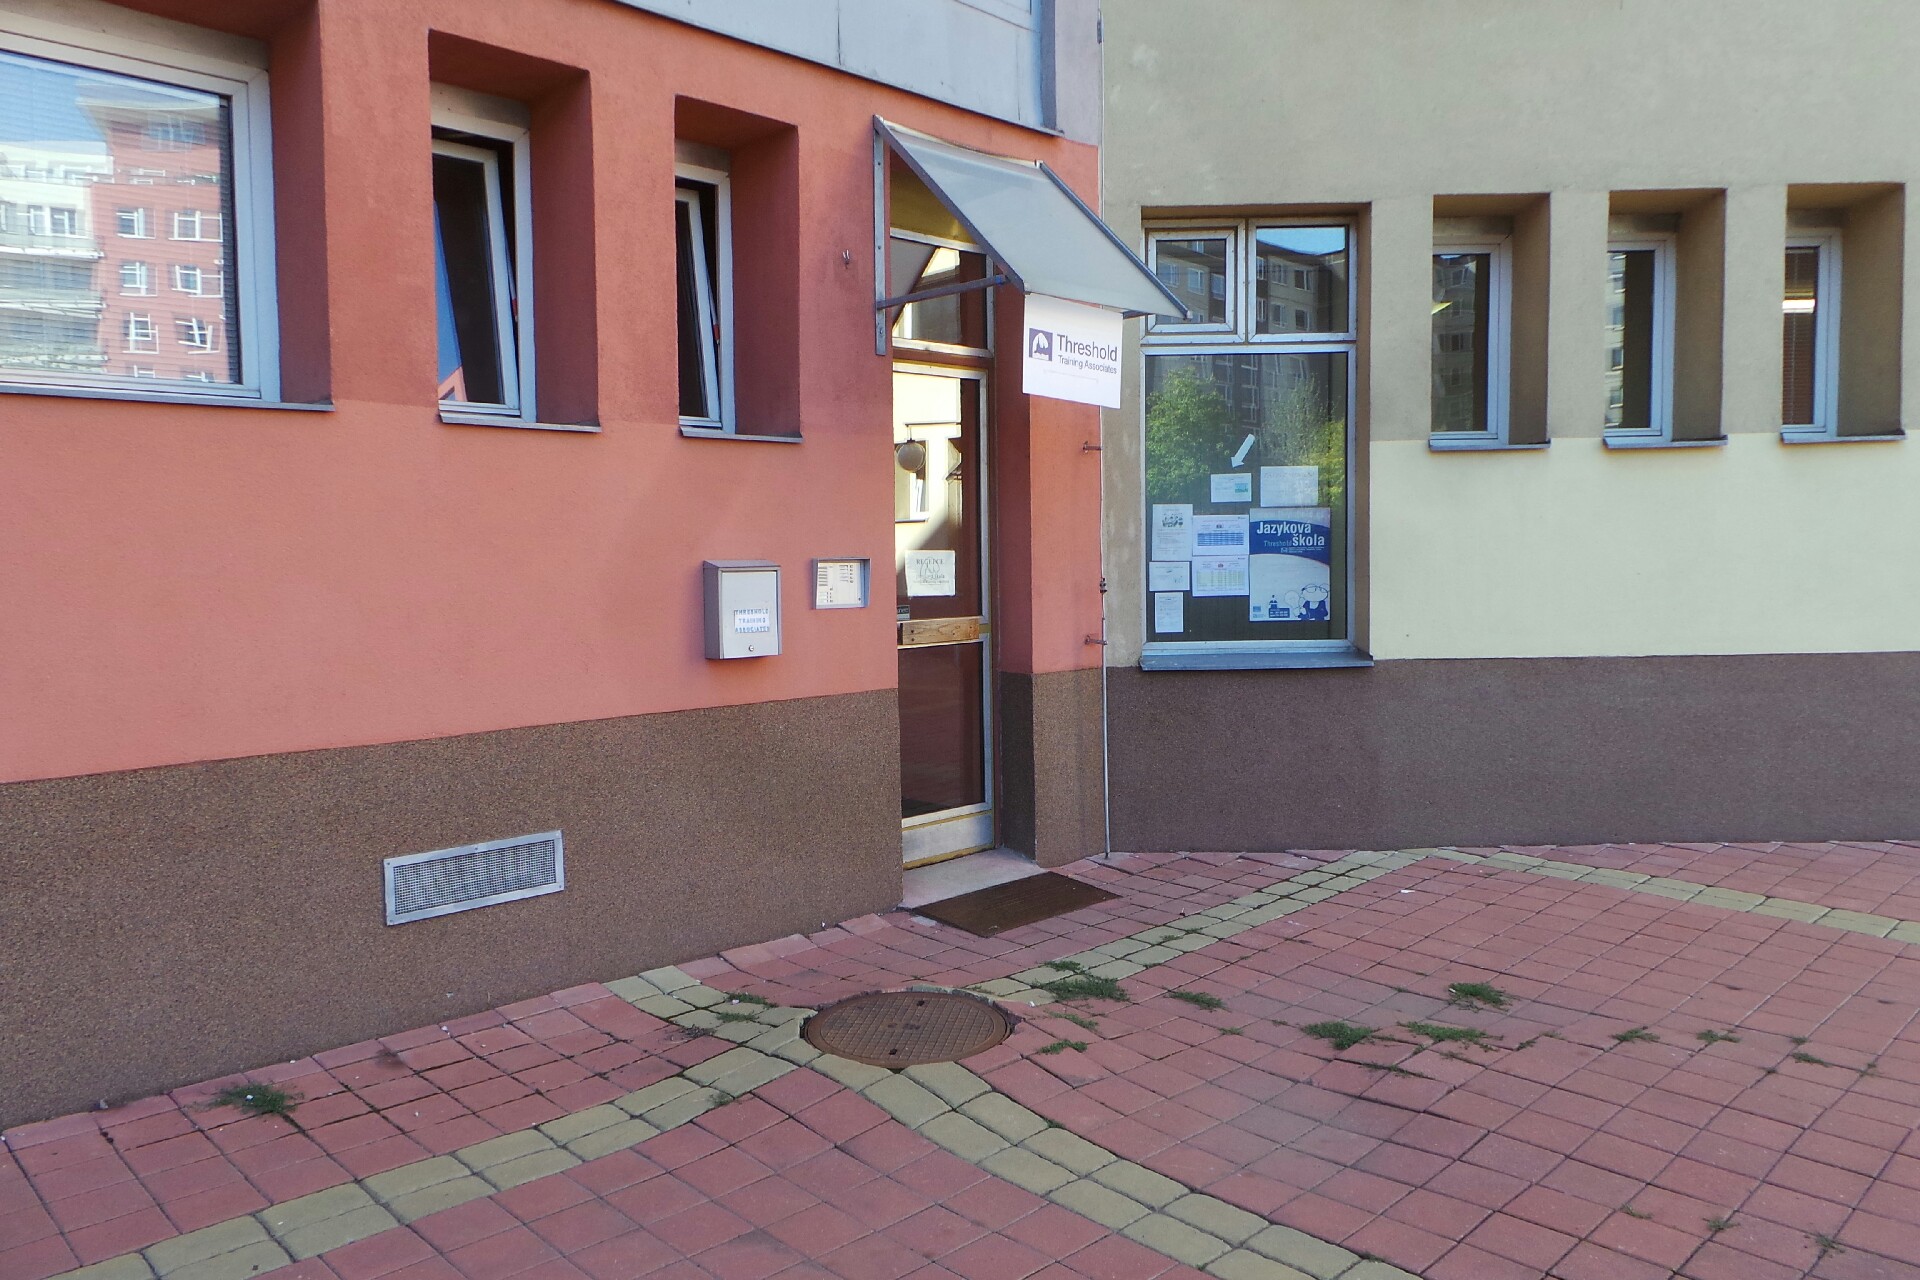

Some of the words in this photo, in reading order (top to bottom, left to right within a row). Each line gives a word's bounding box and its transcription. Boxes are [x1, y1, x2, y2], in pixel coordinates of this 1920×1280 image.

[1057, 334, 1118, 362] Threshold
[1058, 355, 1083, 370] Training
[1084, 360, 1117, 374] Associates
[1257, 520, 1311, 536] Jazyková
[1292, 533, 1325, 546] škola
